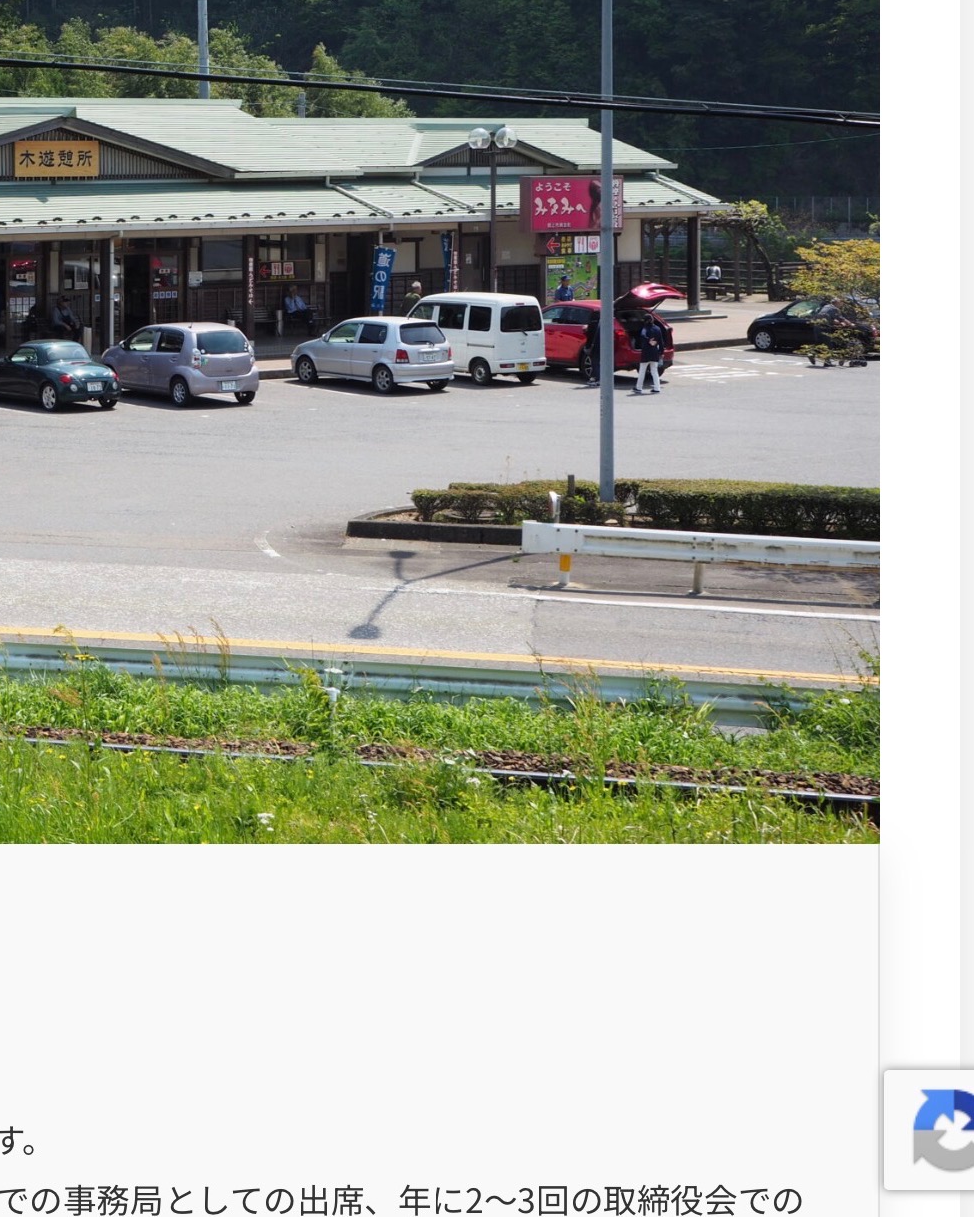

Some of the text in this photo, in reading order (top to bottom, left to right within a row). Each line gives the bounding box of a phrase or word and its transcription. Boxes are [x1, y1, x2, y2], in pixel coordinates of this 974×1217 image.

[19, 150, 93, 168] 木遊憩所
[535, 183, 571, 192] ようこそ
[534, 197, 587, 216] みなみへ
